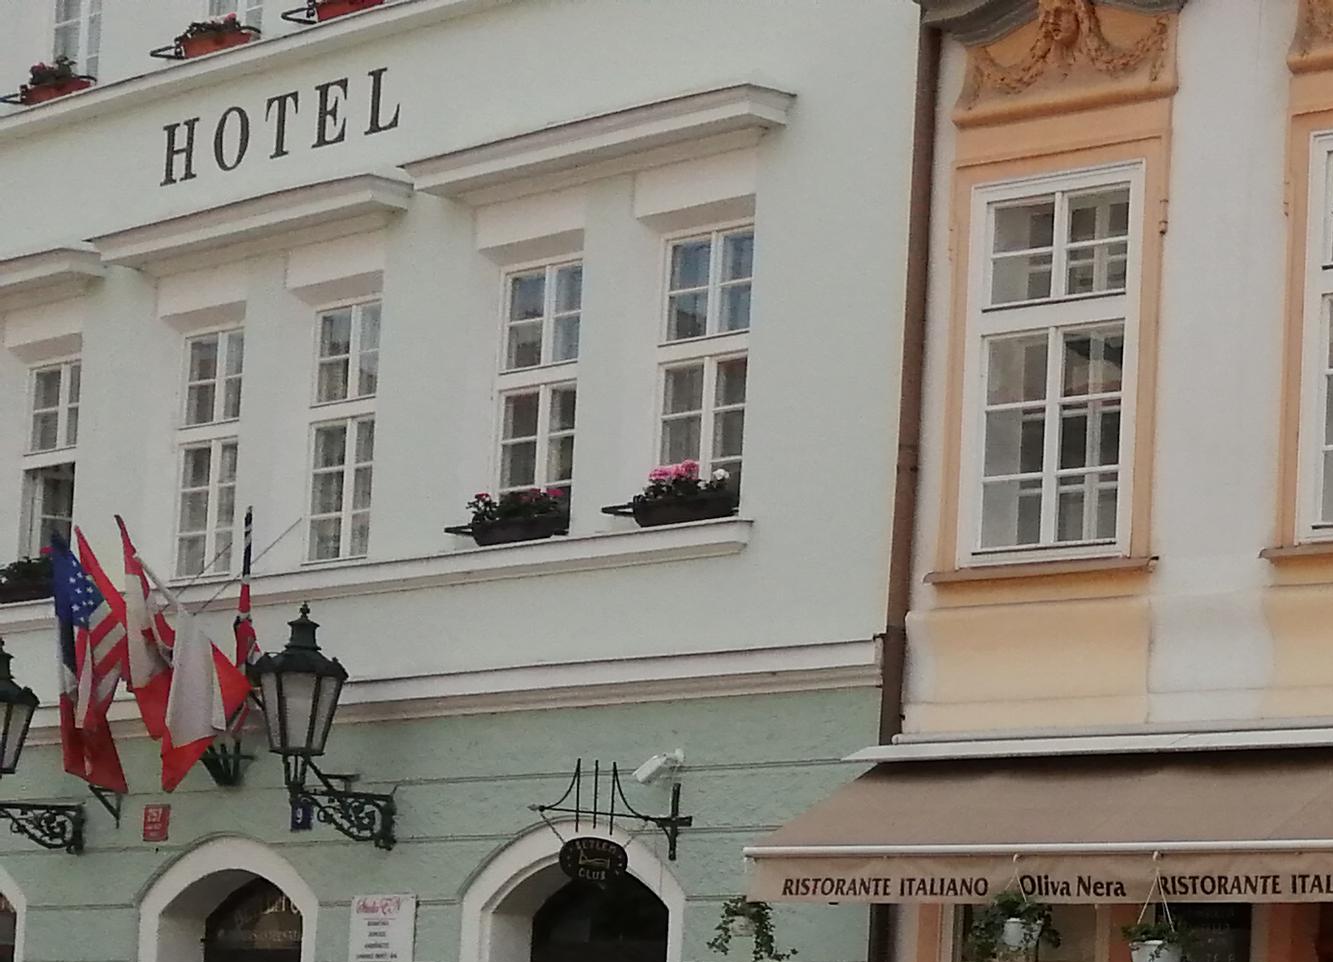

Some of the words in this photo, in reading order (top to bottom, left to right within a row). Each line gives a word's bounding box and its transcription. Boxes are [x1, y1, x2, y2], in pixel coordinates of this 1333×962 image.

[160, 67, 401, 187] HOTEL
[782, 877, 892, 897] RISTORANTE
[899, 876, 990, 898] ITALIANO
[1018, 874, 1072, 898] Oliva
[1076, 876, 1127, 898] Nera
[1157, 875, 1282, 896] RISTORANTE
